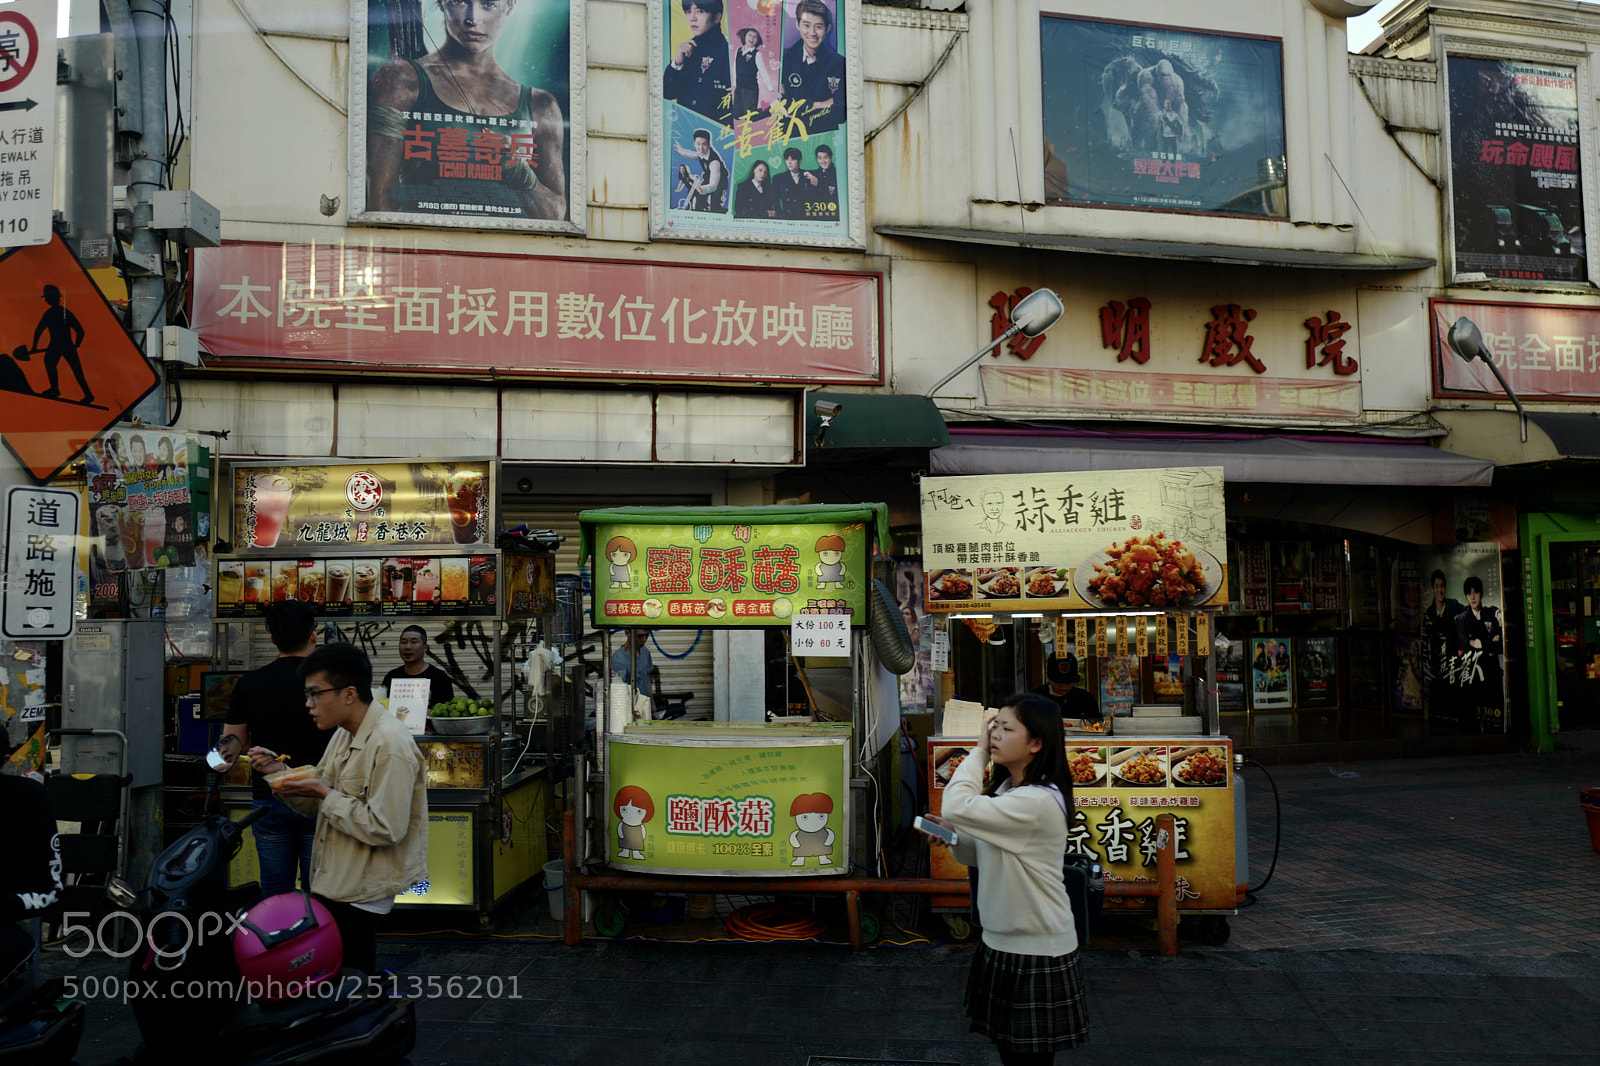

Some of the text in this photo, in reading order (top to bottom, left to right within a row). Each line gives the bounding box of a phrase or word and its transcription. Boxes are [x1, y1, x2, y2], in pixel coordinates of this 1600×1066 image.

[401, 124, 540, 168] 古墓奇兵
[1480, 140, 1578, 171] 玩命颶風
[438, 162, 503, 181] TOMB RAIDER
[1538, 178, 1577, 188] HEIST
[12, 189, 41, 201] ZONE
[216, 275, 854, 350] 本院全面採用數位化放映廳
[1012, 484, 1127, 534] 蒜香雞
[298, 522, 351, 542] 九龍城
[374, 521, 428, 542] 香港茶
[932, 542, 1016, 554] 頂級雞腿肉部位
[647, 545, 800, 594] 鹽酥菇
[669, 602, 706, 614] 香酥菇
[735, 602, 771, 614] 黃金酥
[795, 620, 846, 630] 大份 100 元
[795, 638, 846, 648] 小份 60 元
[669, 797, 771, 834] 鹽酥菇
